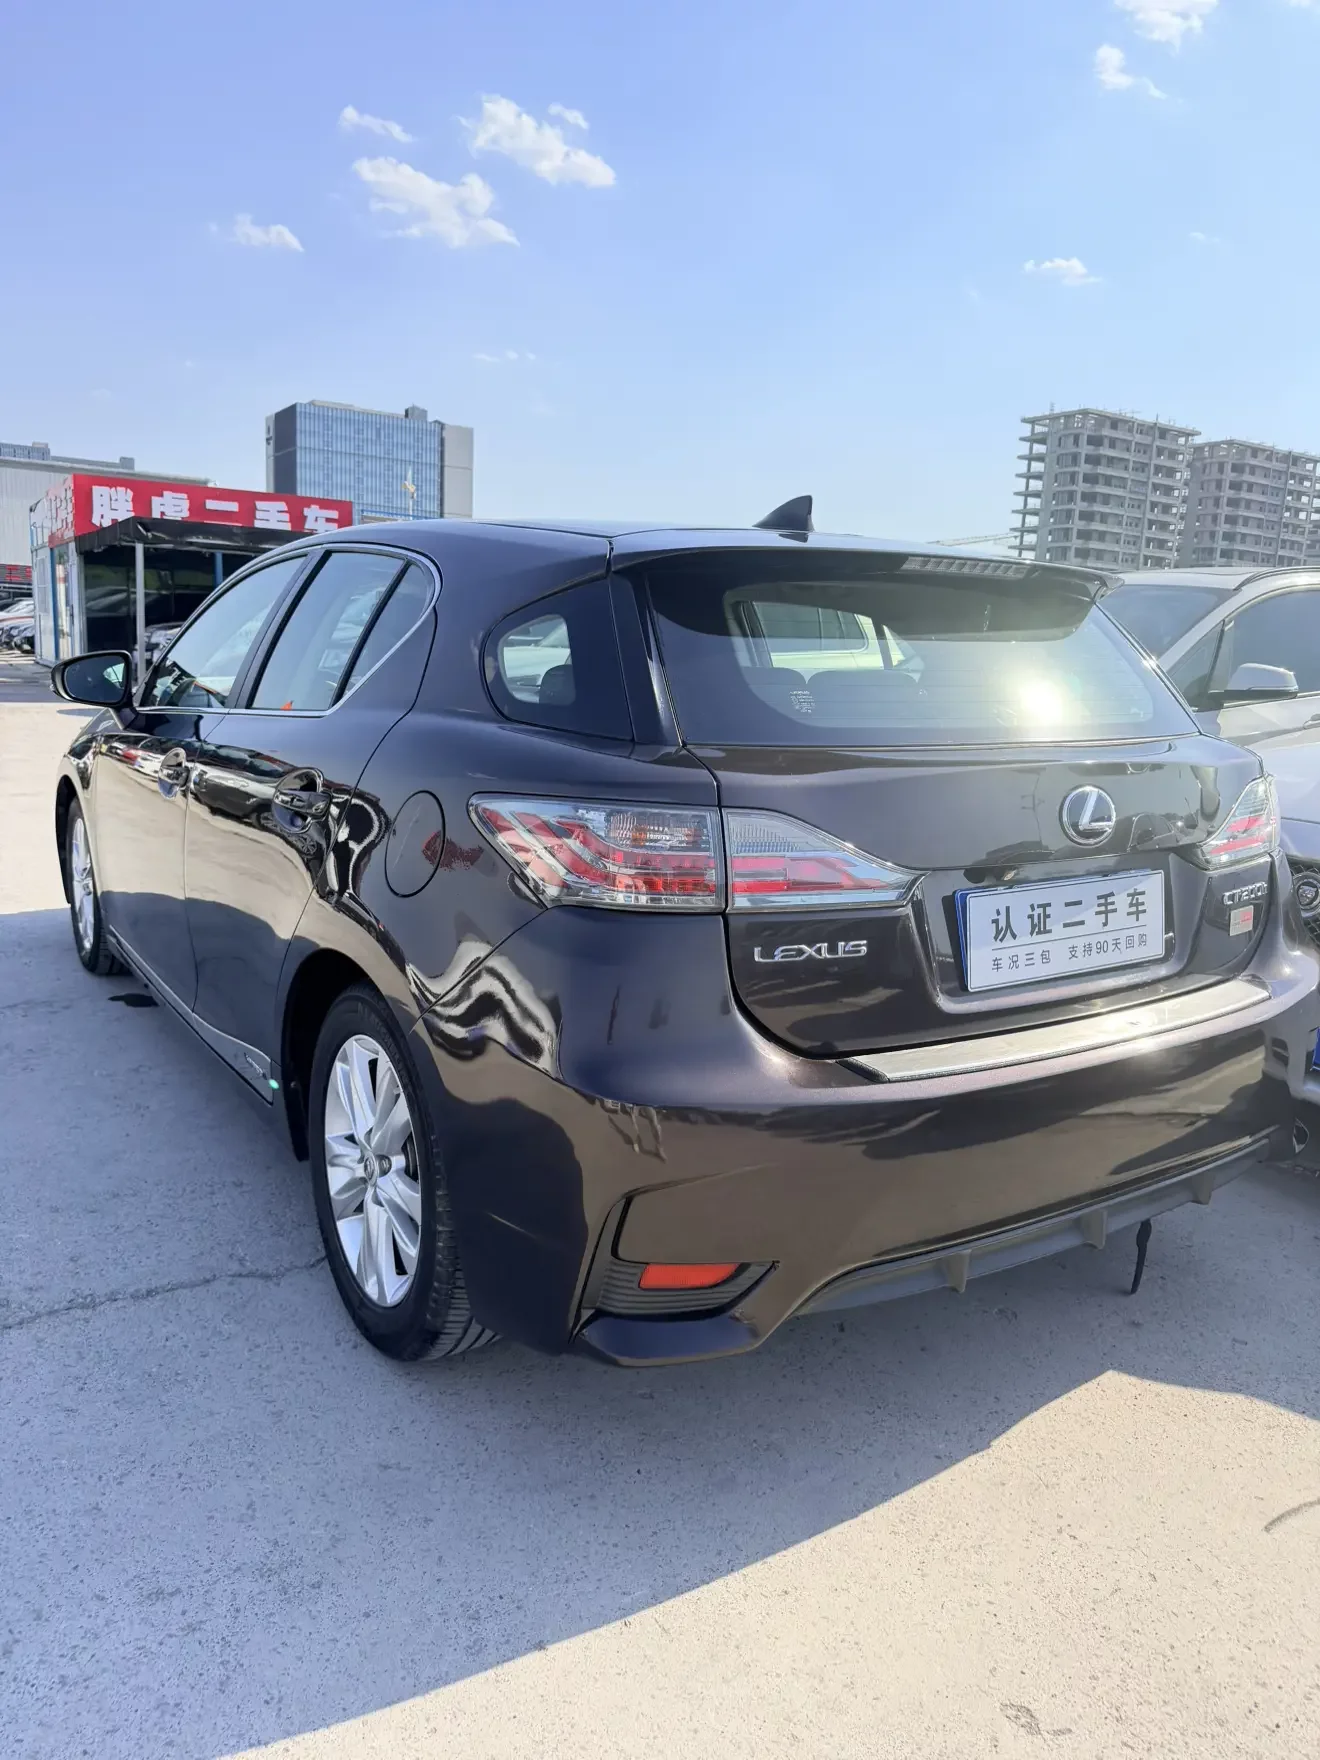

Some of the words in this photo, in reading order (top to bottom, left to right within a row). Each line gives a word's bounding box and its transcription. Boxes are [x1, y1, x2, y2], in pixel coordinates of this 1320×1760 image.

[991, 888, 1147, 943] 认证二手车
[753, 940, 868, 962] LEXUS
[991, 949, 1051, 972] 车况三包
[1068, 933, 1148, 961] 支持90天回购
